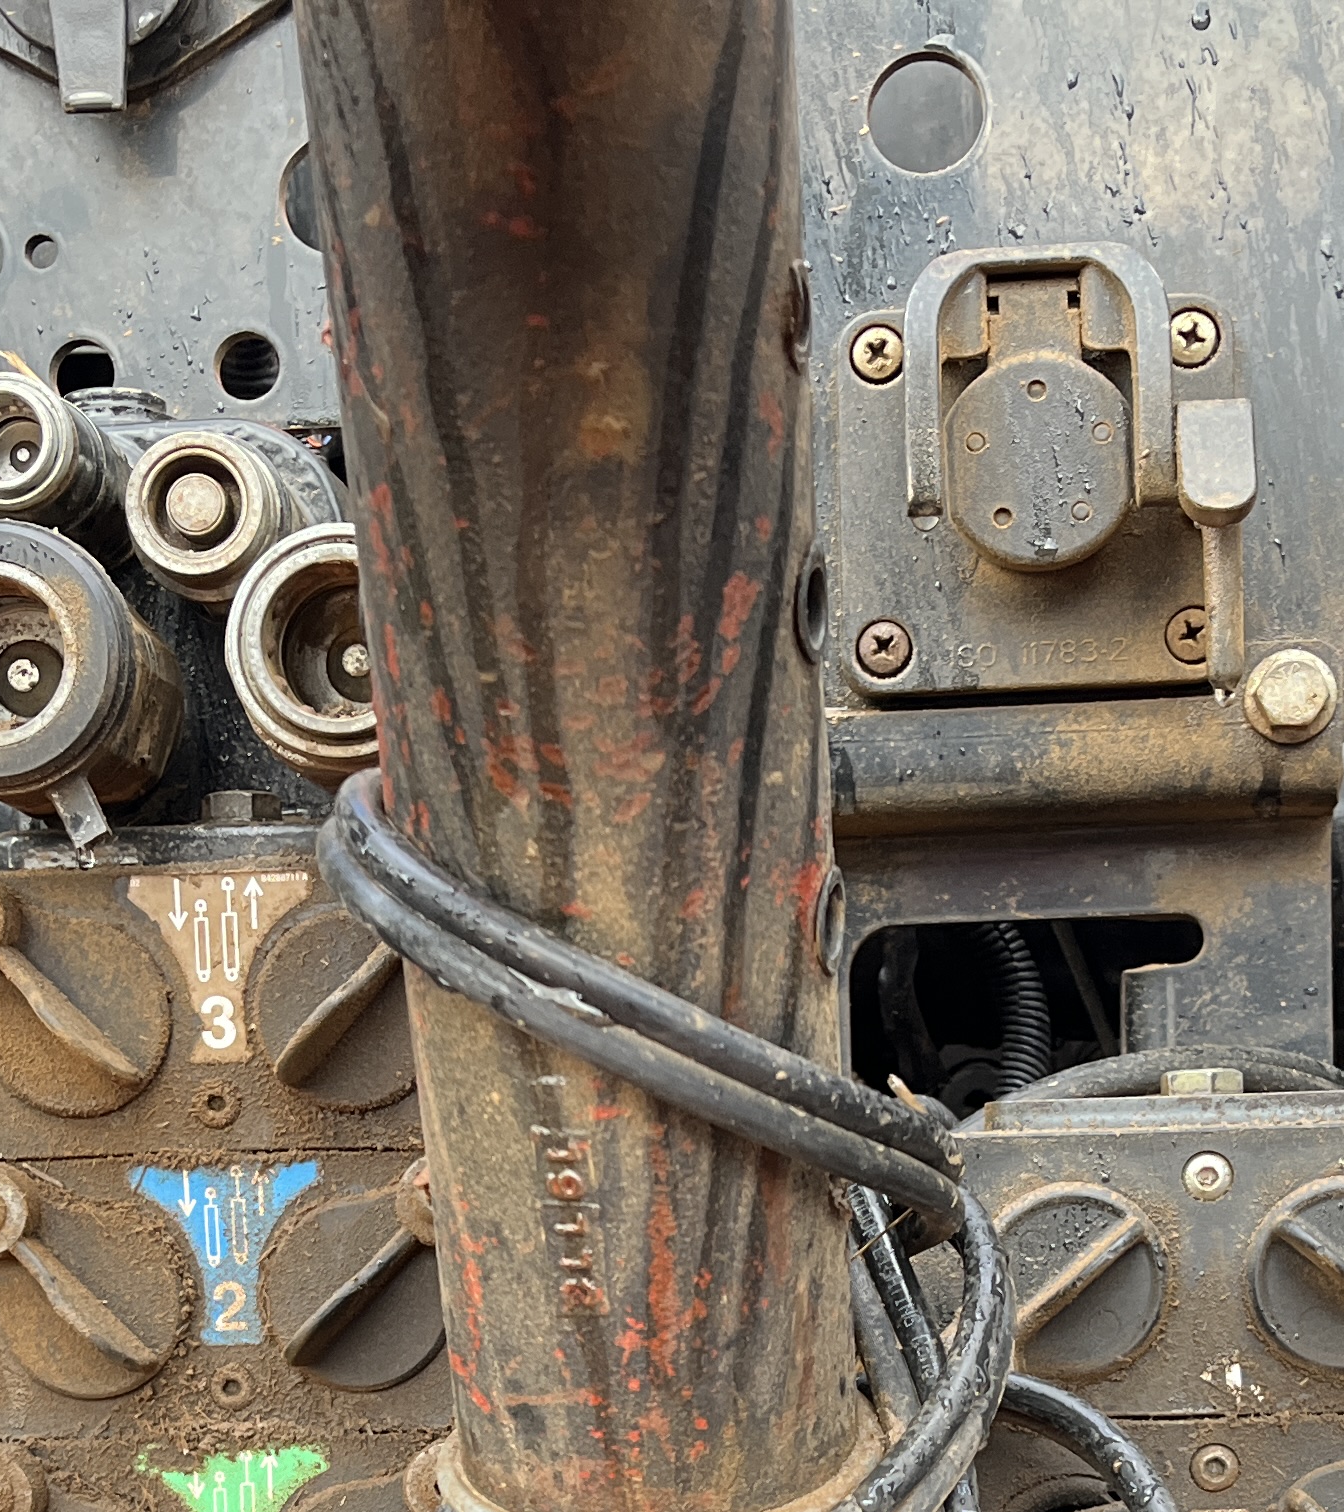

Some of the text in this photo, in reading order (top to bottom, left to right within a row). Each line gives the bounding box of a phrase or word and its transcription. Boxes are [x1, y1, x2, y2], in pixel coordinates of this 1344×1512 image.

[1021, 637, 1130, 666] 11783-2
[200, 995, 237, 1050] 3
[212, 1280, 249, 1332] 2
